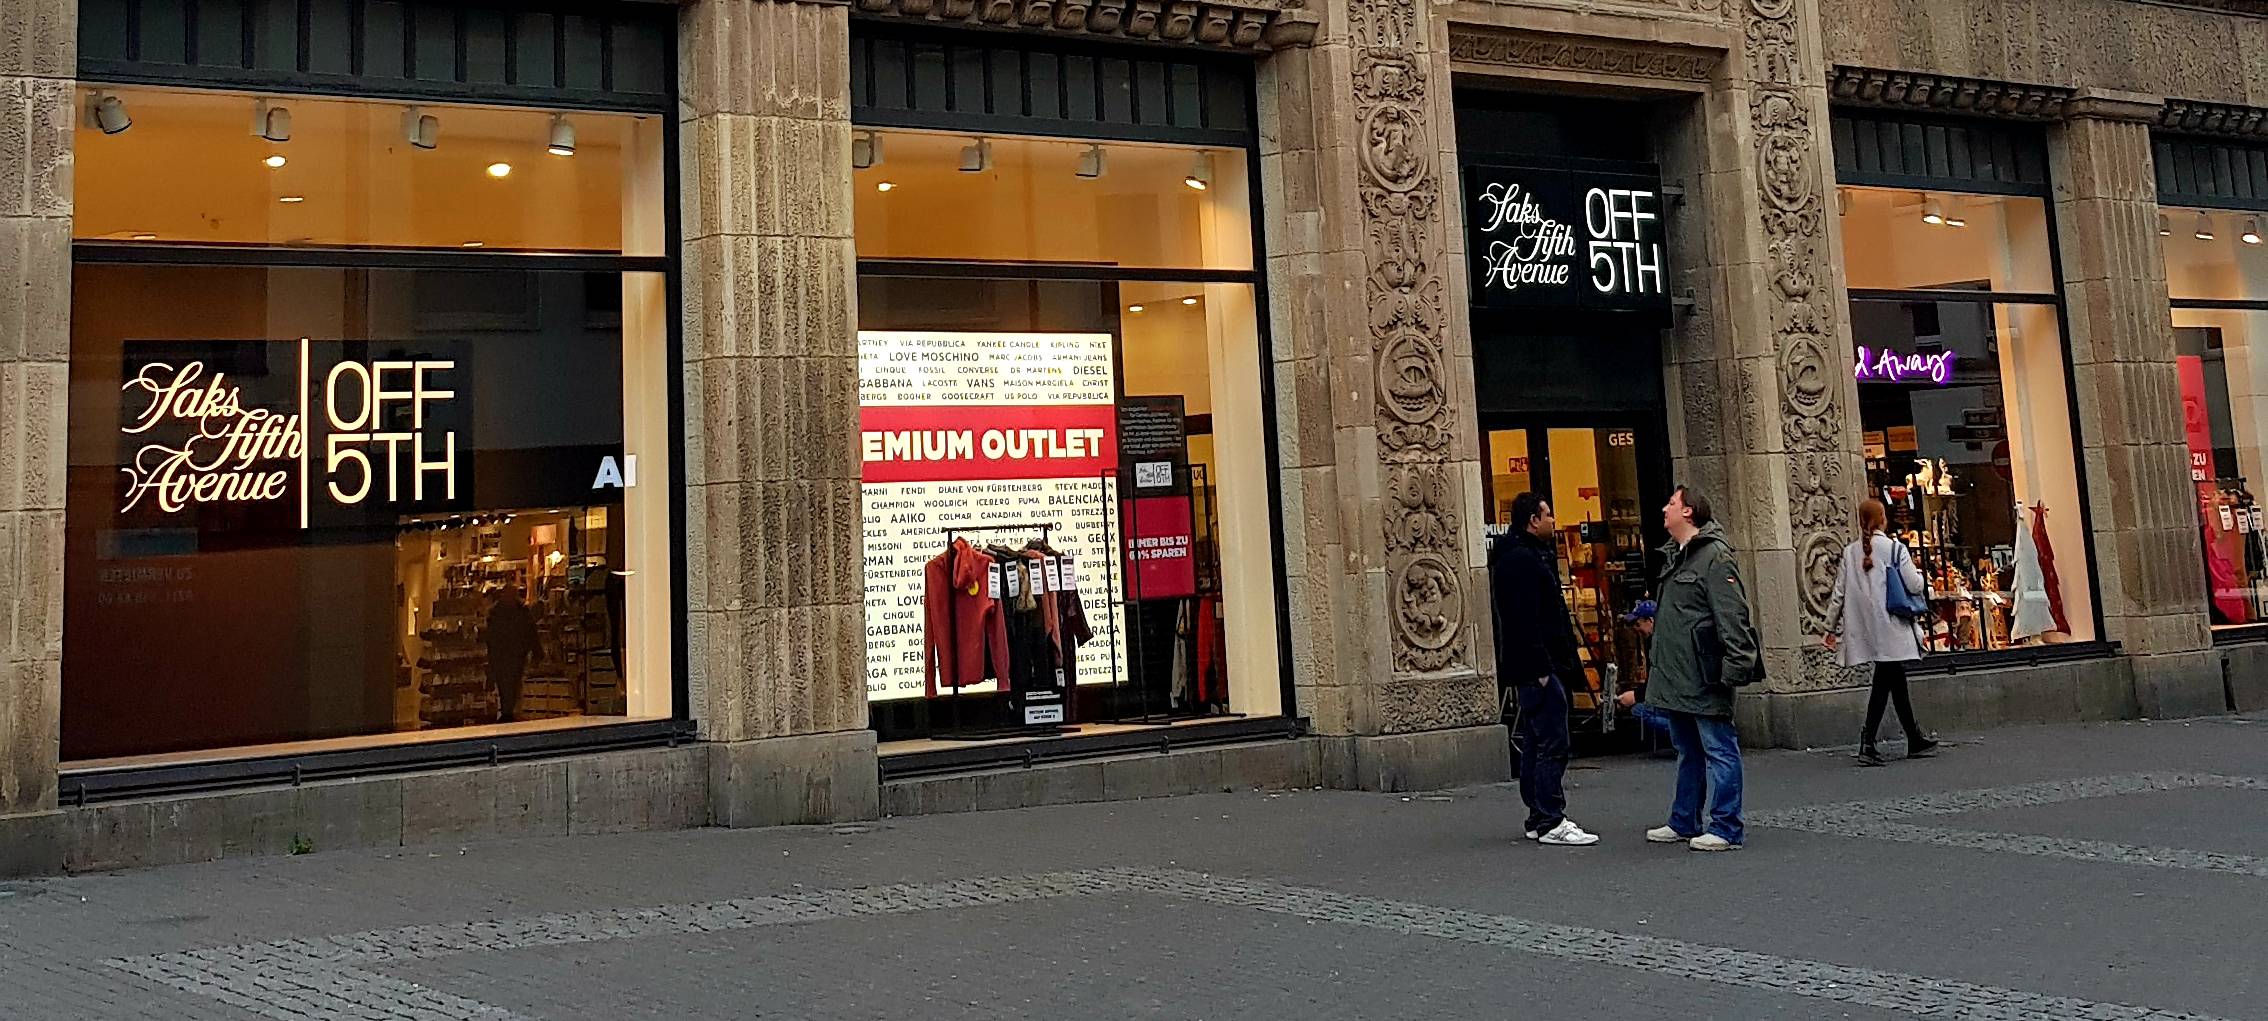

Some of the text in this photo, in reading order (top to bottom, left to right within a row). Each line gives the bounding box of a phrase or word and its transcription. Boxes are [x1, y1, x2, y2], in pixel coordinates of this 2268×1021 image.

[1479, 183, 1540, 232] Saks
[1586, 188, 1654, 240] OFF
[1482, 241, 1568, 289] Avenue
[1589, 241, 1661, 293] 5TH
[890, 352, 918, 361] LOVE
[922, 352, 979, 362] MOSCHINO
[1073, 366, 1108, 375] DIESEL
[1872, 348, 1952, 382] Away
[859, 379, 912, 388] GABBANA
[966, 379, 994, 388] VANS
[121, 360, 239, 434] Saks
[326, 360, 454, 430] OFF
[862, 428, 1104, 462] EMIUM OUTLET
[1608, 432, 1634, 446] GES
[2192, 453, 2206, 466] ZU
[328, 432, 455, 504] 5TH
[121, 444, 287, 514] Avenue
[901, 486, 926, 494] FENDI
[872, 501, 914, 510] CHAMPION
[890, 513, 926, 523] AAIKO
[981, 511, 1022, 519] CANADIAN
[1030, 510, 1062, 518] BUGATTI
[868, 542, 902, 551] MISSONI
[1160, 536, 1174, 546] BIS
[1176, 536, 1188, 546] ZU
[1151, 547, 1186, 558] SPAREN
[883, 612, 914, 620] CINQUE
[867, 623, 922, 636] GABBANA
